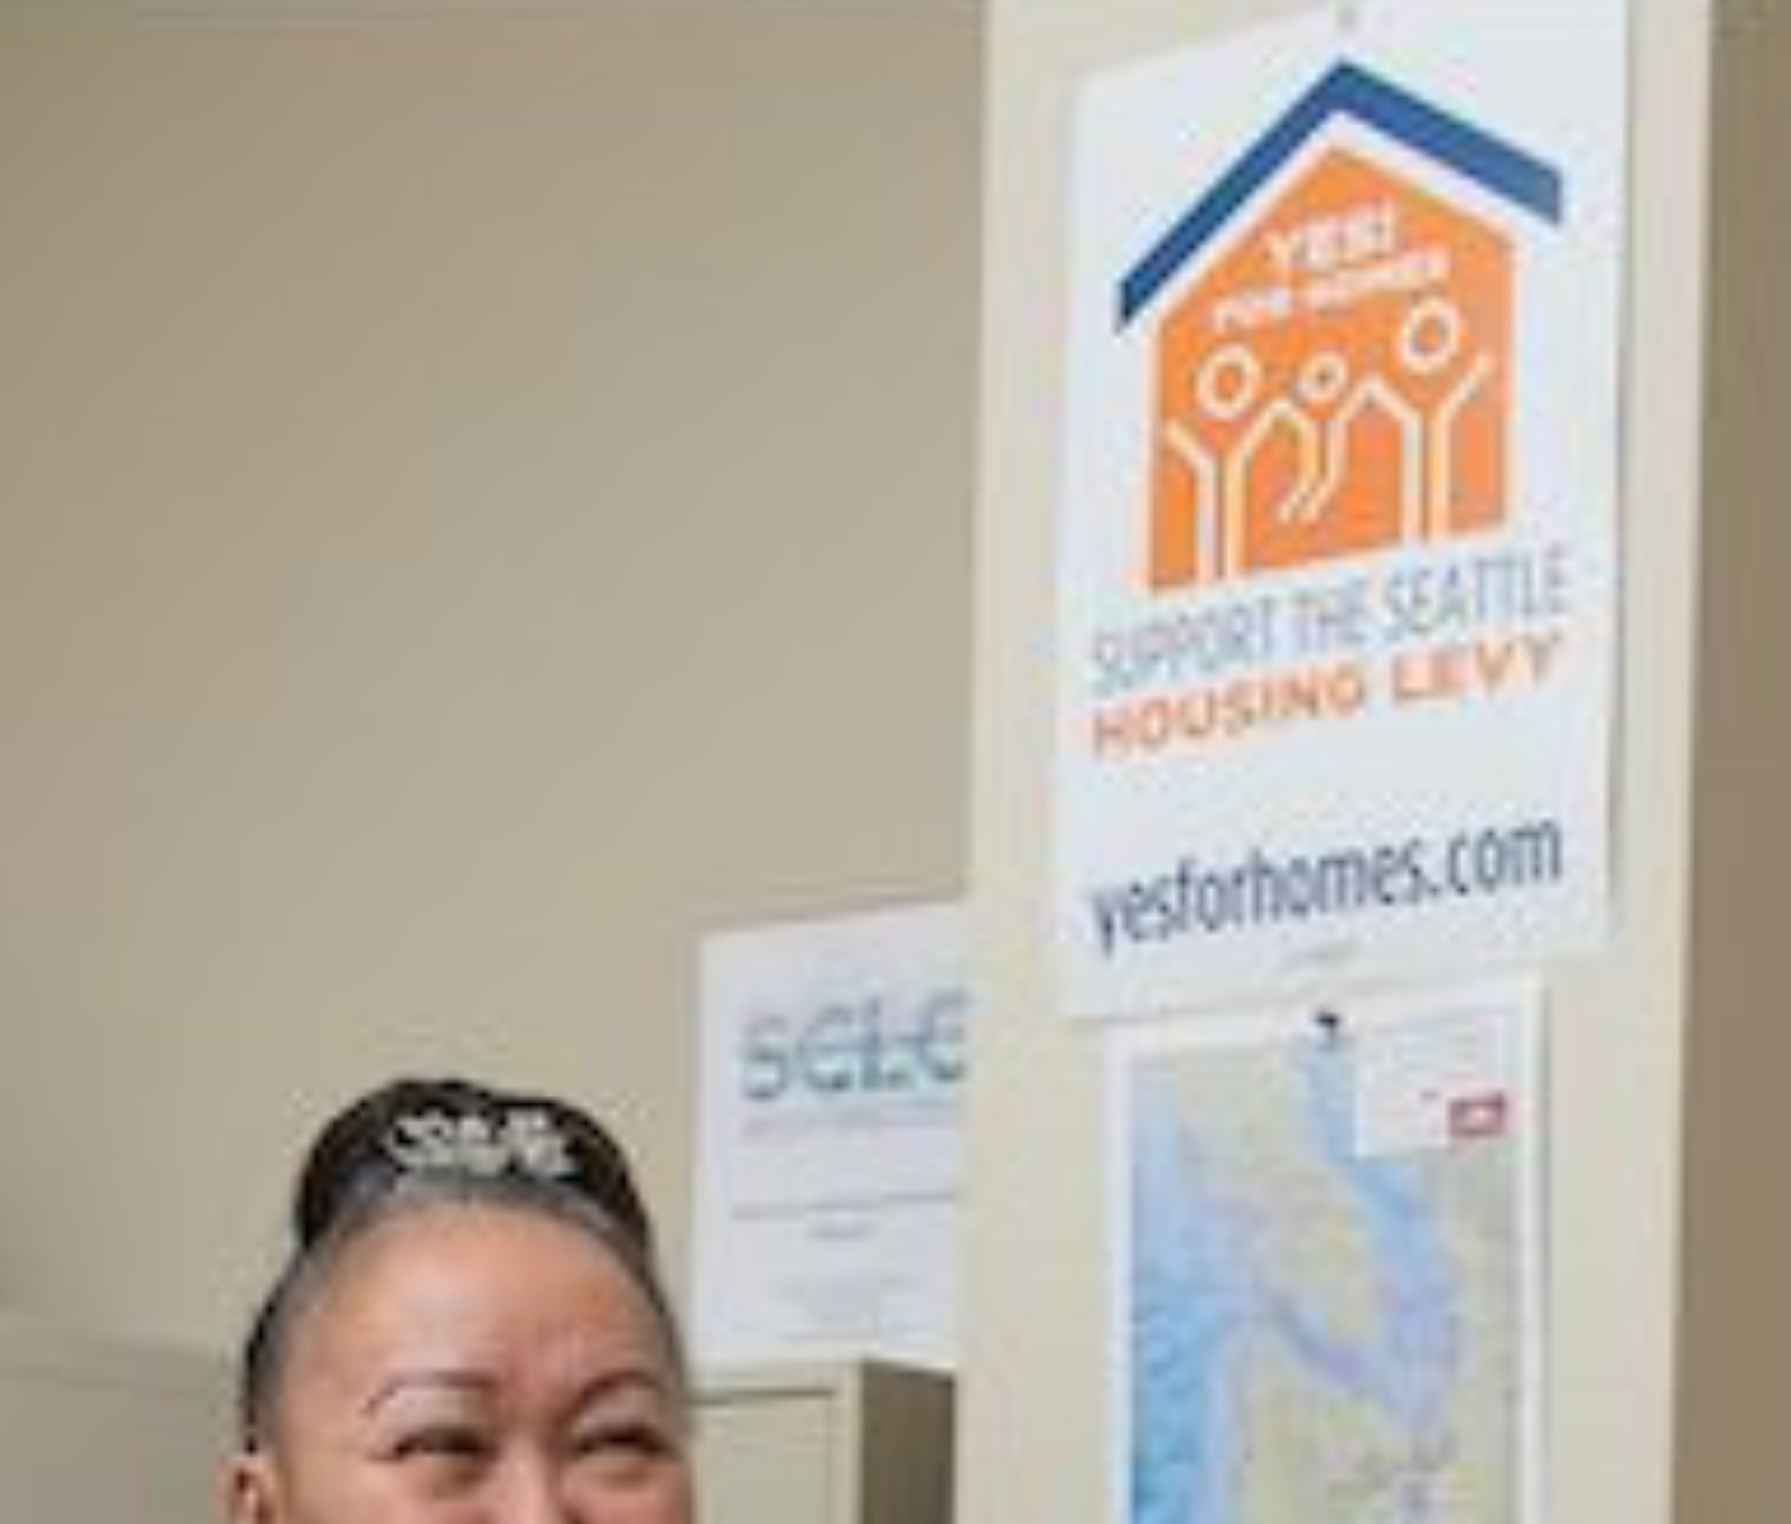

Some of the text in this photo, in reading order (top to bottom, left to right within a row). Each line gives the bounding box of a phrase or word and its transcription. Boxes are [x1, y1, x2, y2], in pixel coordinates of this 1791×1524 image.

[1266, 200, 1398, 280] YES!
[1093, 542, 1568, 697] SUPPORT THE SEATTLE
[1093, 630, 1562, 758] HOUSING LEVY
[1091, 818, 1563, 958] yesforhomes.com
